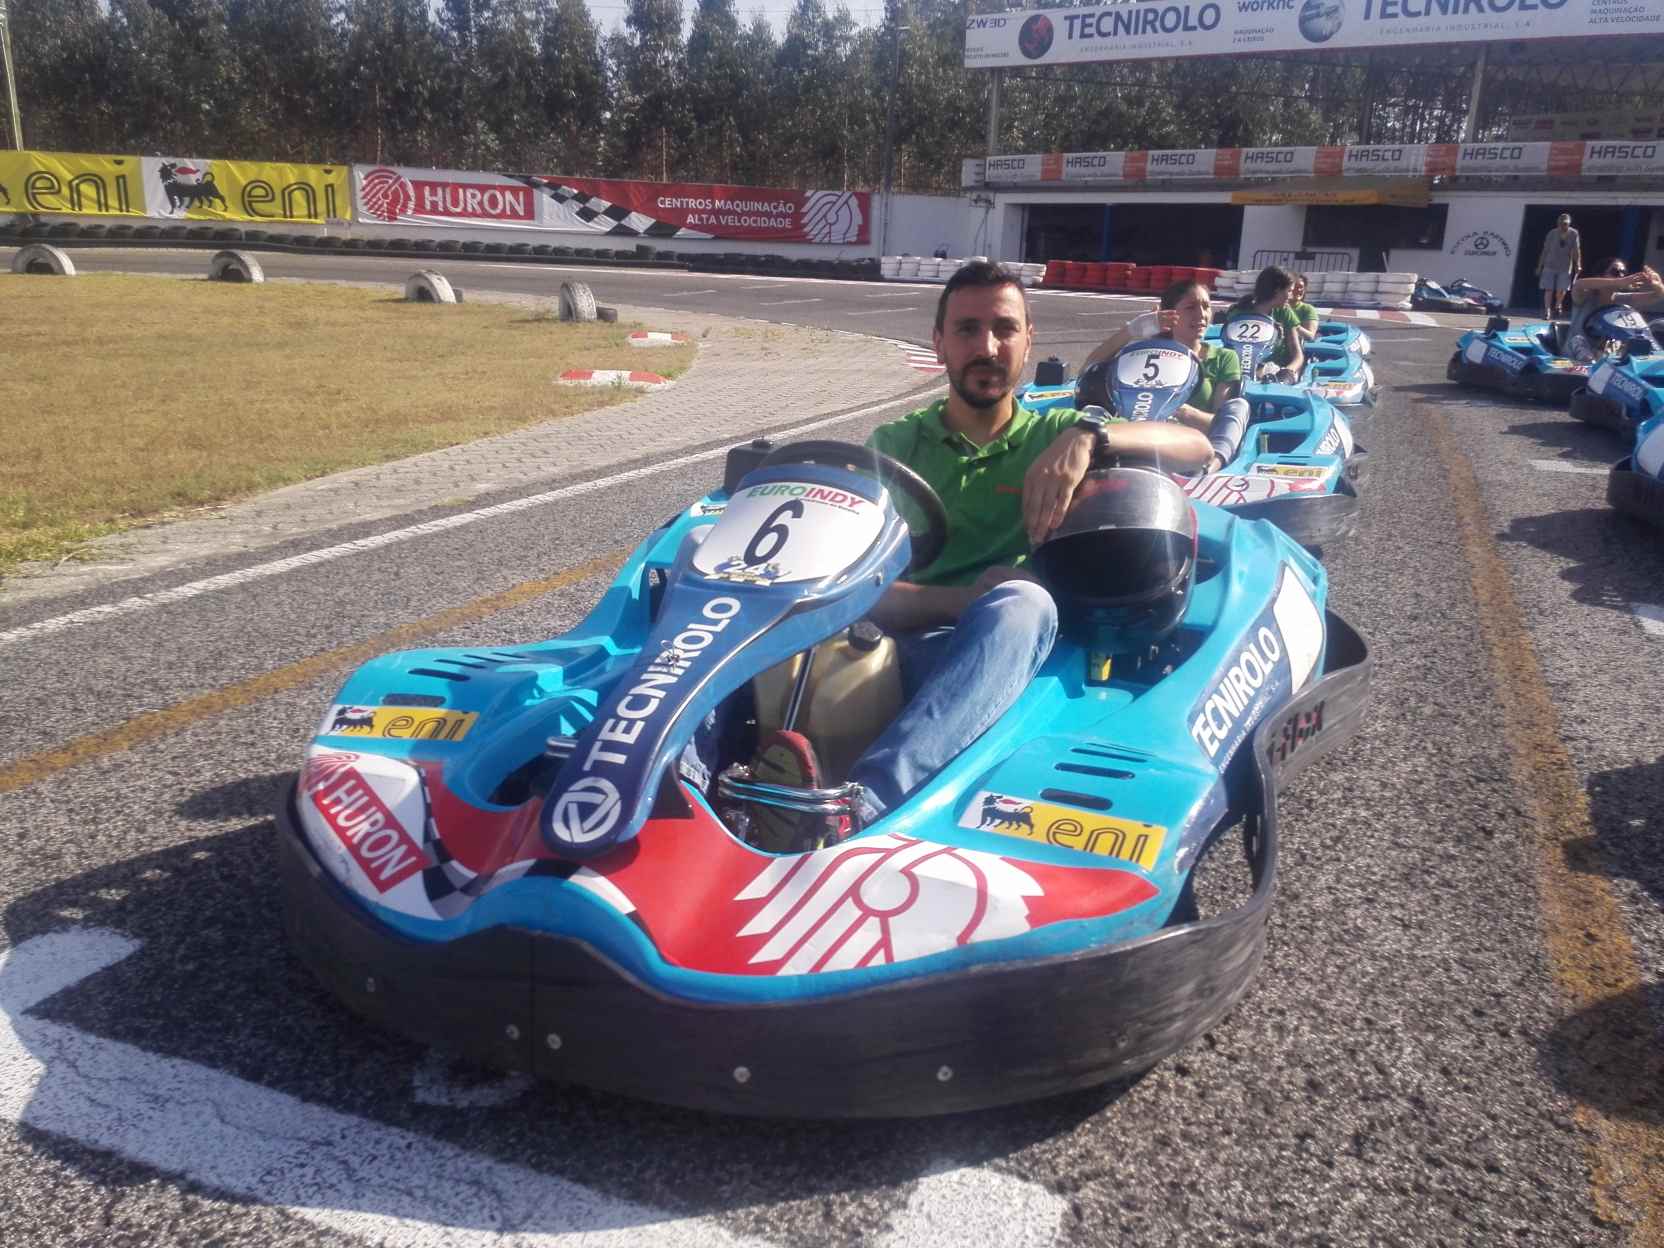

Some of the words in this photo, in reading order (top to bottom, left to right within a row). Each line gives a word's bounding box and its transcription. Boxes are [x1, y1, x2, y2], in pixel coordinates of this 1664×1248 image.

[1063, 3, 1221, 40] TECNIROLO
[1066, 156, 1106, 168] HASCO
[1151, 153, 1196, 166] HASCO
[1244, 151, 1295, 164] HASCO
[1347, 149, 1402, 162] HASCO
[1462, 147, 1523, 160] HASCO
[1589, 145, 1657, 159] HASCO
[987, 159, 1025, 169] HASCO
[24, 159, 130, 213] eni
[241, 169, 336, 220] eni
[423, 186, 525, 216] HURON
[657, 197, 712, 210] CENTROS
[715, 200, 795, 214] MAQUINAÇÃO
[686, 214, 718, 225] ALTA
[719, 215, 793, 229] VELOCIDADE
[1237, 323, 1262, 339] 22
[1142, 354, 1160, 382] 5
[745, 485, 867, 508] EUROINDY
[743, 498, 805, 566] 6
[582, 596, 742, 772] TECNIROLO
[382, 710, 470, 741] eni
[321, 779, 417, 881] HURON
[1045, 818, 1153, 864] eni
